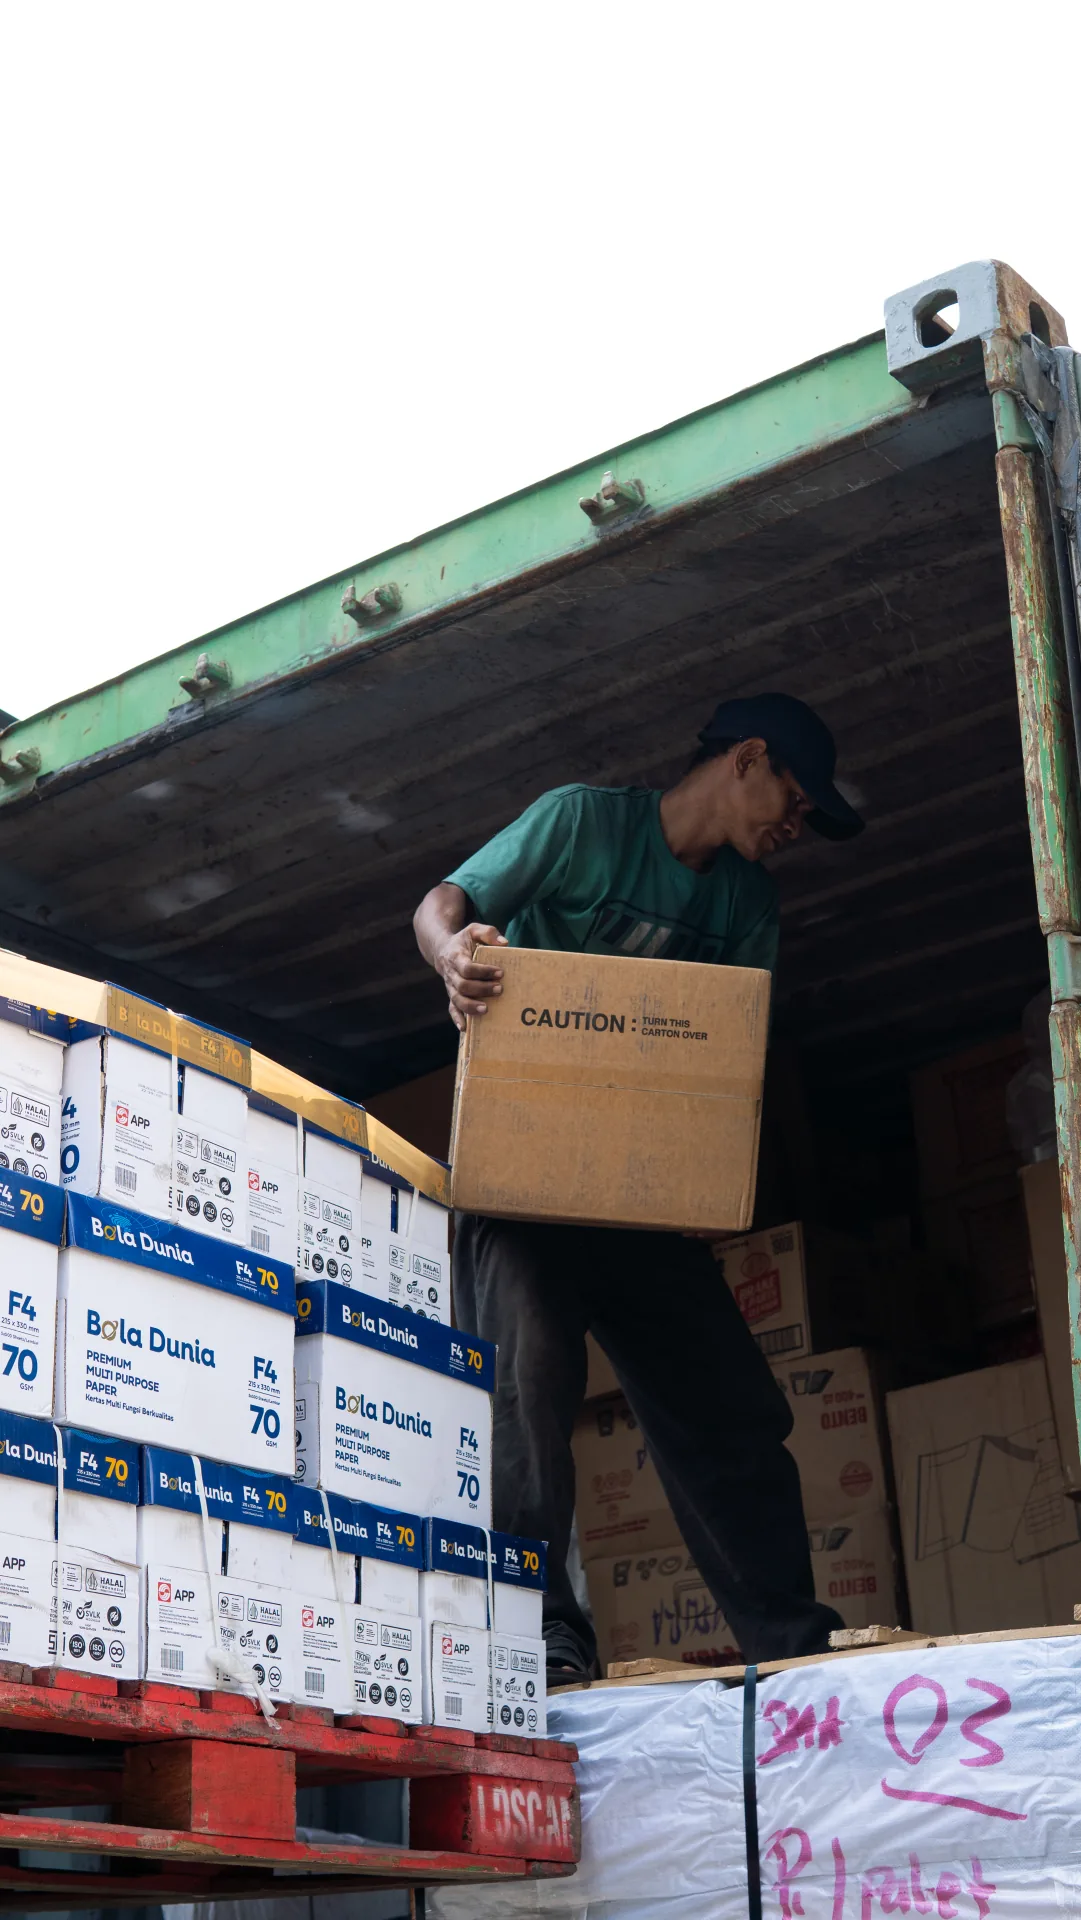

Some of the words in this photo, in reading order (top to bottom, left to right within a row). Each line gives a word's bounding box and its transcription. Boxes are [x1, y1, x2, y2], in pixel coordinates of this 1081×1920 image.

[642, 1016, 667, 1026] TURN
[669, 1018, 690, 1028] THIS
[120, 1006, 151, 1032] Bla
[153, 1021, 190, 1048] Duia
[223, 1045, 243, 1068] 70
[641, 1027, 680, 1038] CARTON
[682, 1031, 708, 1041] OVER
[25, 1103, 48, 1117] HALAL
[61, 1096, 77, 1118] 4
[130, 1115, 150, 1129] APP
[60, 1144, 80, 1175] 0
[213, 1149, 234, 1163] HALAL
[63, 1175, 77, 1184] GSM
[261, 1181, 279, 1194] APP
[20, 1189, 44, 1216] 70
[333, 1209, 350, 1221] HALAL
[361, 1237, 372, 1249] PP
[91, 1217, 137, 1248] Bola
[139, 1232, 194, 1266] Dunia
[236, 1260, 253, 1279] F4
[257, 1267, 279, 1290] 70
[423, 1262, 440, 1274] HALAL
[8, 1289, 36, 1322] F4
[297, 1298, 312, 1317] 0
[16, 1321, 27, 1330] 330
[86, 1309, 143, 1349] Bola
[149, 1326, 216, 1368] Dunia
[342, 1304, 376, 1333] Bola
[378, 1317, 418, 1349] Dunia
[450, 1342, 464, 1360] F4
[467, 1348, 483, 1370] 70
[2, 1343, 38, 1381] 70
[86, 1349, 132, 1370] PREMIUM
[253, 1355, 278, 1384] F4
[86, 1364, 113, 1380] MULTI
[115, 1372, 160, 1392] PURPOSE
[20, 1382, 34, 1392] GSM
[85, 1379, 117, 1396] PAPER
[271, 1387, 281, 1395] mm
[85, 1393, 105, 1405] Kertas
[106, 1398, 122, 1409] Multi
[122, 1402, 141, 1414] Fungsi
[142, 1407, 174, 1421] Berkualitas
[335, 1385, 378, 1421] Bola
[382, 1400, 432, 1438] Dunia
[249, 1404, 281, 1439] 70
[821, 1406, 867, 1430] BENTO
[335, 1422, 370, 1441] PREMIUM
[460, 1426, 479, 1452] F4
[265, 1439, 278, 1448] GSM
[335, 1436, 356, 1450] MULTI
[357, 1443, 390, 1461] PURPOSE
[0, 1439, 21, 1458] ola
[24, 1443, 67, 1470] Dunia
[80, 1451, 98, 1471] F4
[105, 1456, 128, 1481] 70
[335, 1449, 359, 1465] PAPER
[335, 1462, 350, 1473] Kertas
[362, 1470, 376, 1480] Fungsi
[377, 1474, 402, 1487] Berkualitas
[159, 1472, 192, 1494] Bola
[242, 1485, 260, 1504] F4
[265, 1489, 287, 1512] 70
[457, 1470, 480, 1502] 70
[468, 1502, 478, 1510] GSM
[333, 1517, 368, 1539] Dunia
[376, 1521, 392, 1539] F4
[396, 1525, 415, 1547] 70
[440, 1538, 466, 1558] Bola
[467, 1544, 497, 1564] Duna
[505, 1547, 518, 1563] F4
[522, 1550, 539, 1571] 70
[2, 1556, 26, 1571] APP
[100, 1576, 124, 1588] HALAL
[828, 1576, 877, 1597] BENTO
[174, 1589, 195, 1602] APP
[85, 1610, 101, 1619] SVLK
[260, 1606, 280, 1617] HALAL
[316, 1615, 335, 1628] APP
[247, 1638, 261, 1647] SVLK
[392, 1632, 410, 1642] HALAL
[72, 1640, 82, 1649] ISO
[92, 1643, 102, 1652] ISO
[454, 1643, 470, 1655] APP
[381, 1661, 393, 1670] SVLK
[520, 1656, 537, 1665] HALAL
